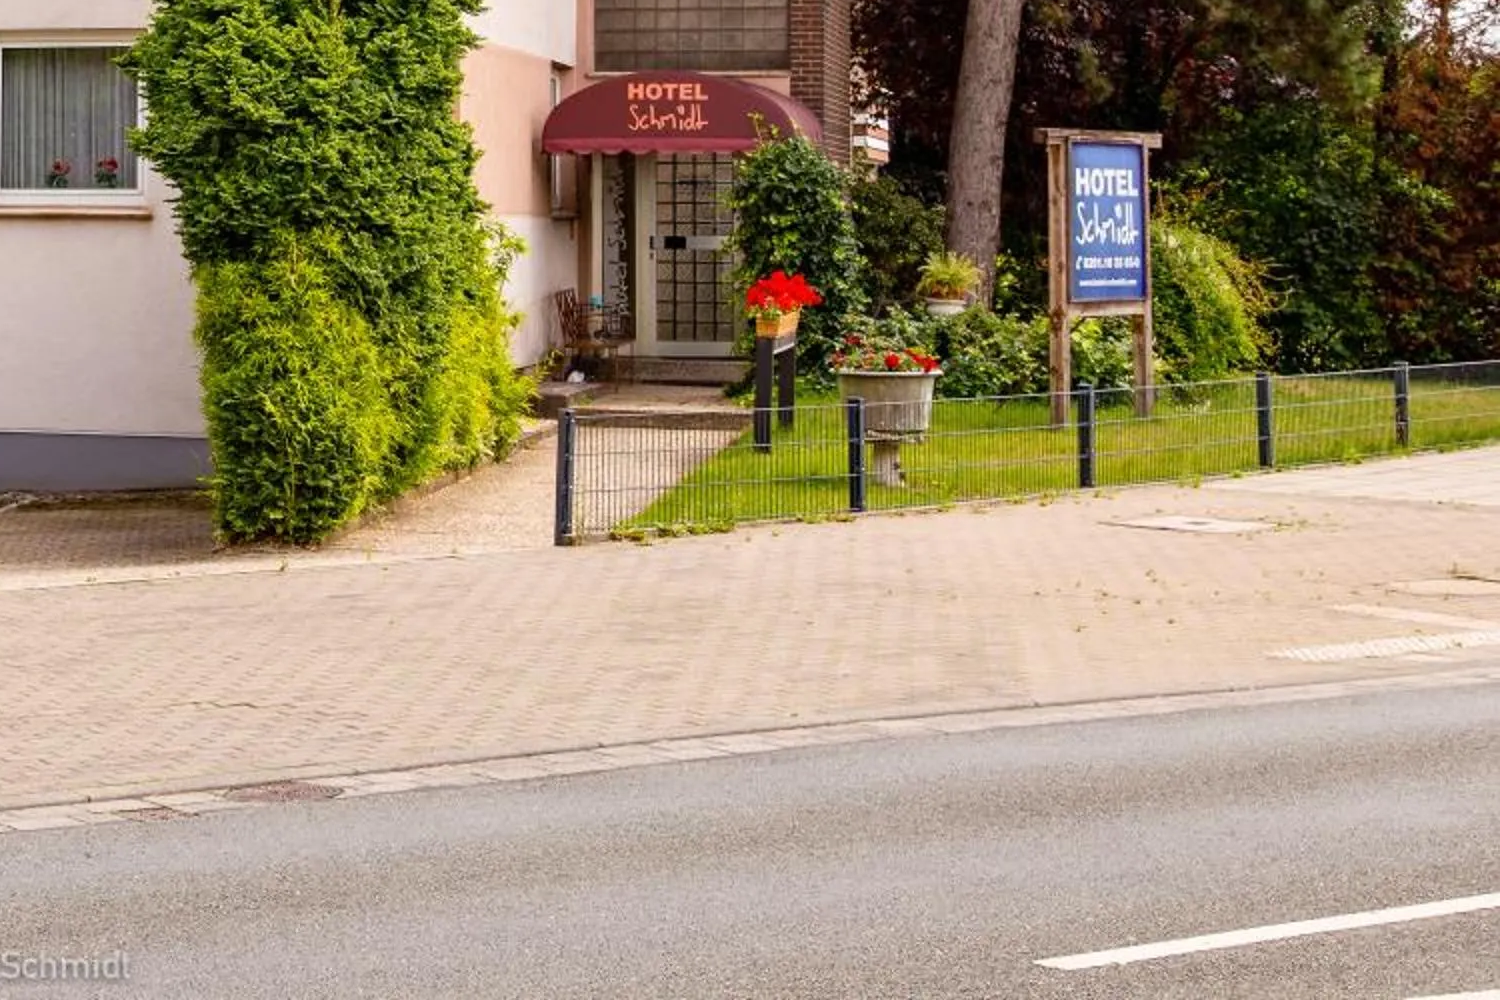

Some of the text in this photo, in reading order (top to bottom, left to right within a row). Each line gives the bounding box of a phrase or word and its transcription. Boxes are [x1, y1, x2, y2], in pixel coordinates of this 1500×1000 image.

[627, 83, 709, 101] HOTEL
[627, 104, 709, 132] Schmidt
[1075, 167, 1139, 197] HOTEL
[1075, 201, 1140, 245] Schmidt
